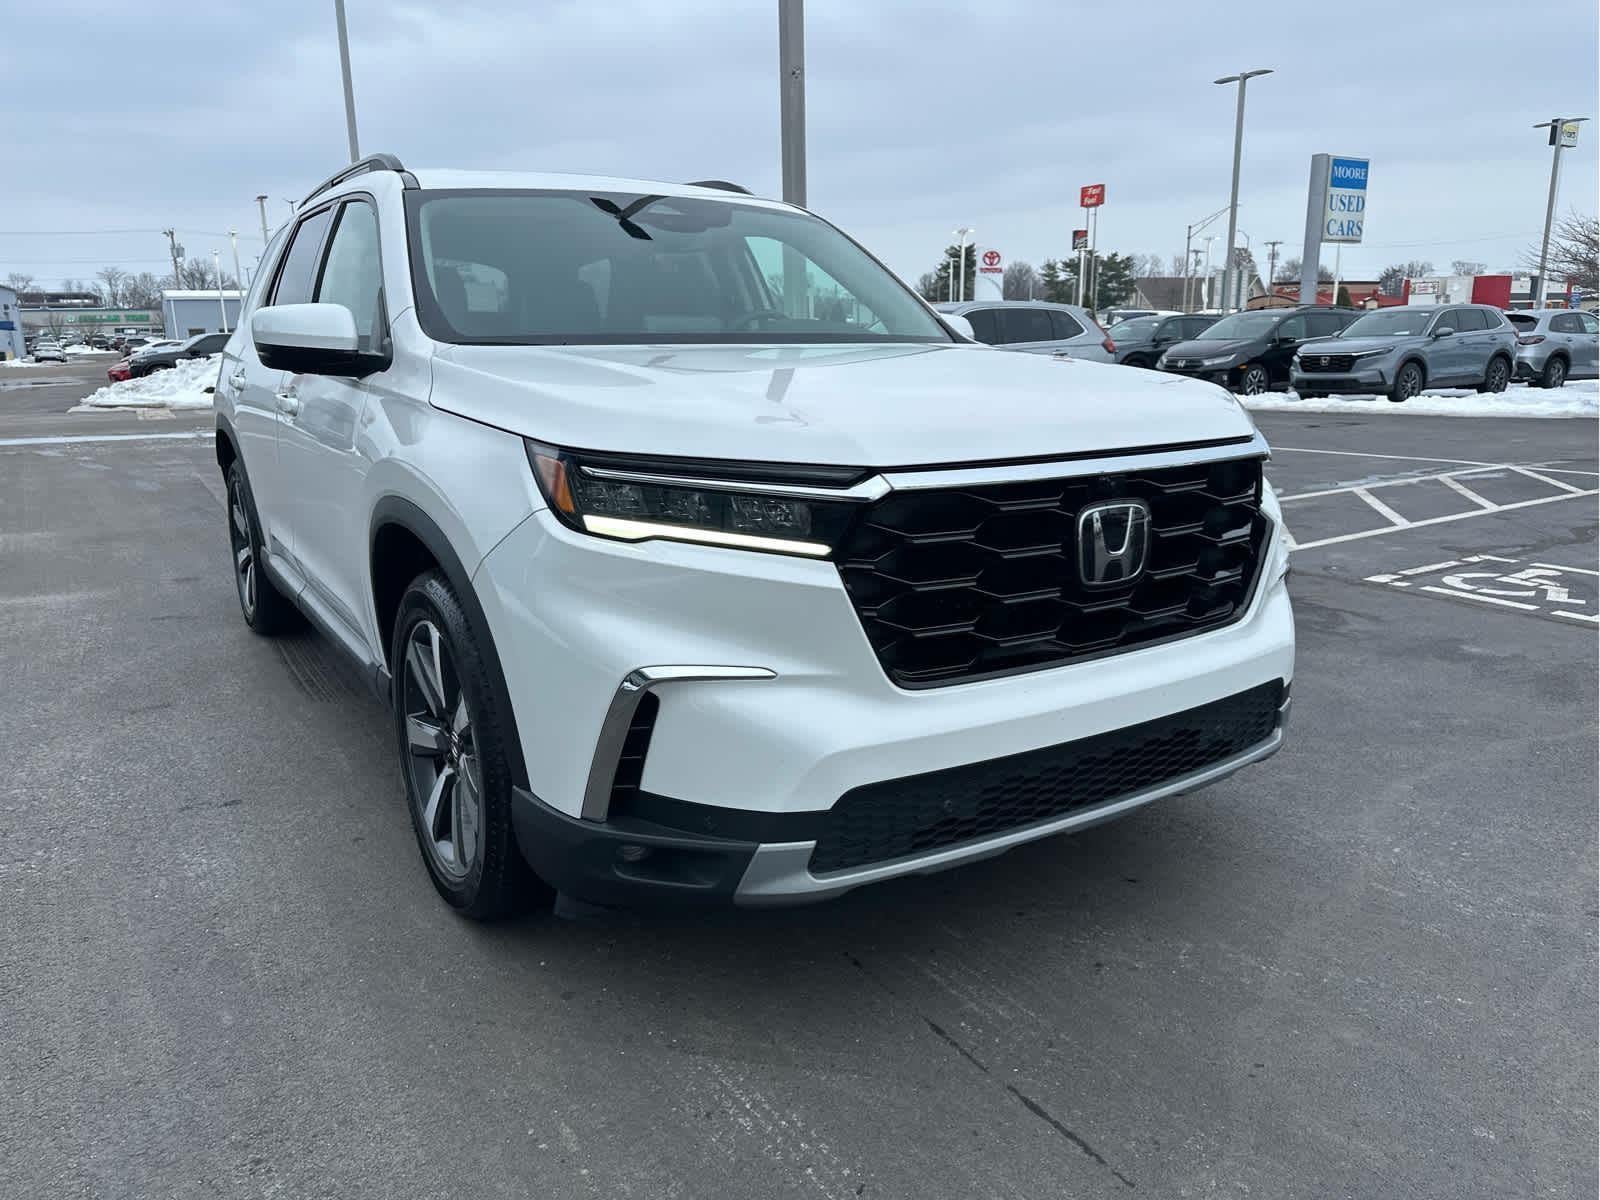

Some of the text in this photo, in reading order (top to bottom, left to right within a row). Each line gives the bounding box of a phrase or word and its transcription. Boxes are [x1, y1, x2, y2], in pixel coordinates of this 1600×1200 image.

[1333, 165, 1367, 179] MOORE
[1330, 194, 1365, 212] USED
[1327, 218, 1362, 236] CARS
